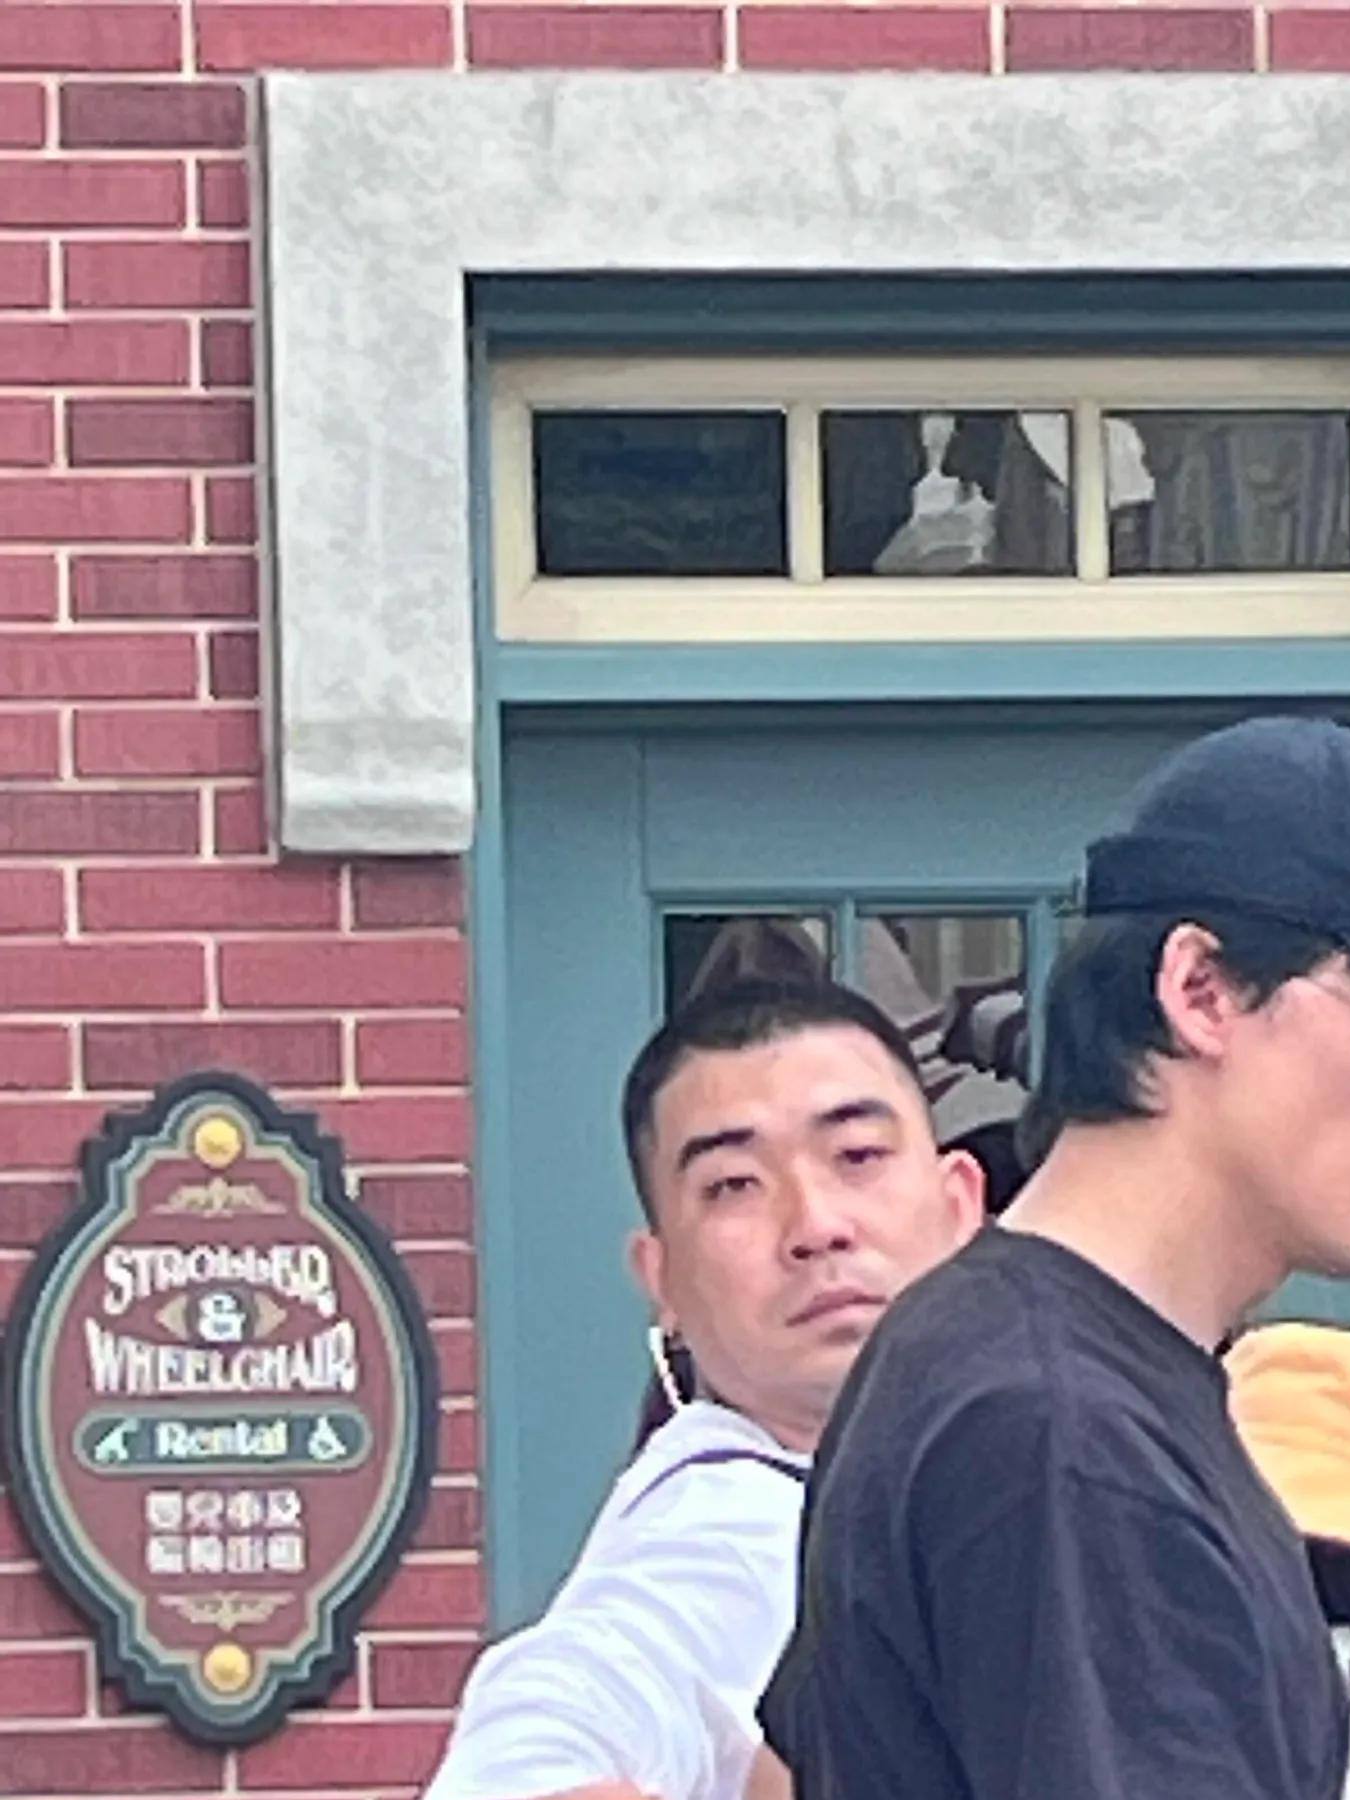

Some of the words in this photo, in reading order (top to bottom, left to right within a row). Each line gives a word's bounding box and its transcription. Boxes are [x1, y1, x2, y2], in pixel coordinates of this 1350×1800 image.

[103, 1245, 337, 1317] STROLLER
[197, 1293, 245, 1342] &
[85, 1317, 358, 1394] WHEELCHAIR
[155, 1418, 288, 1456] Rental
